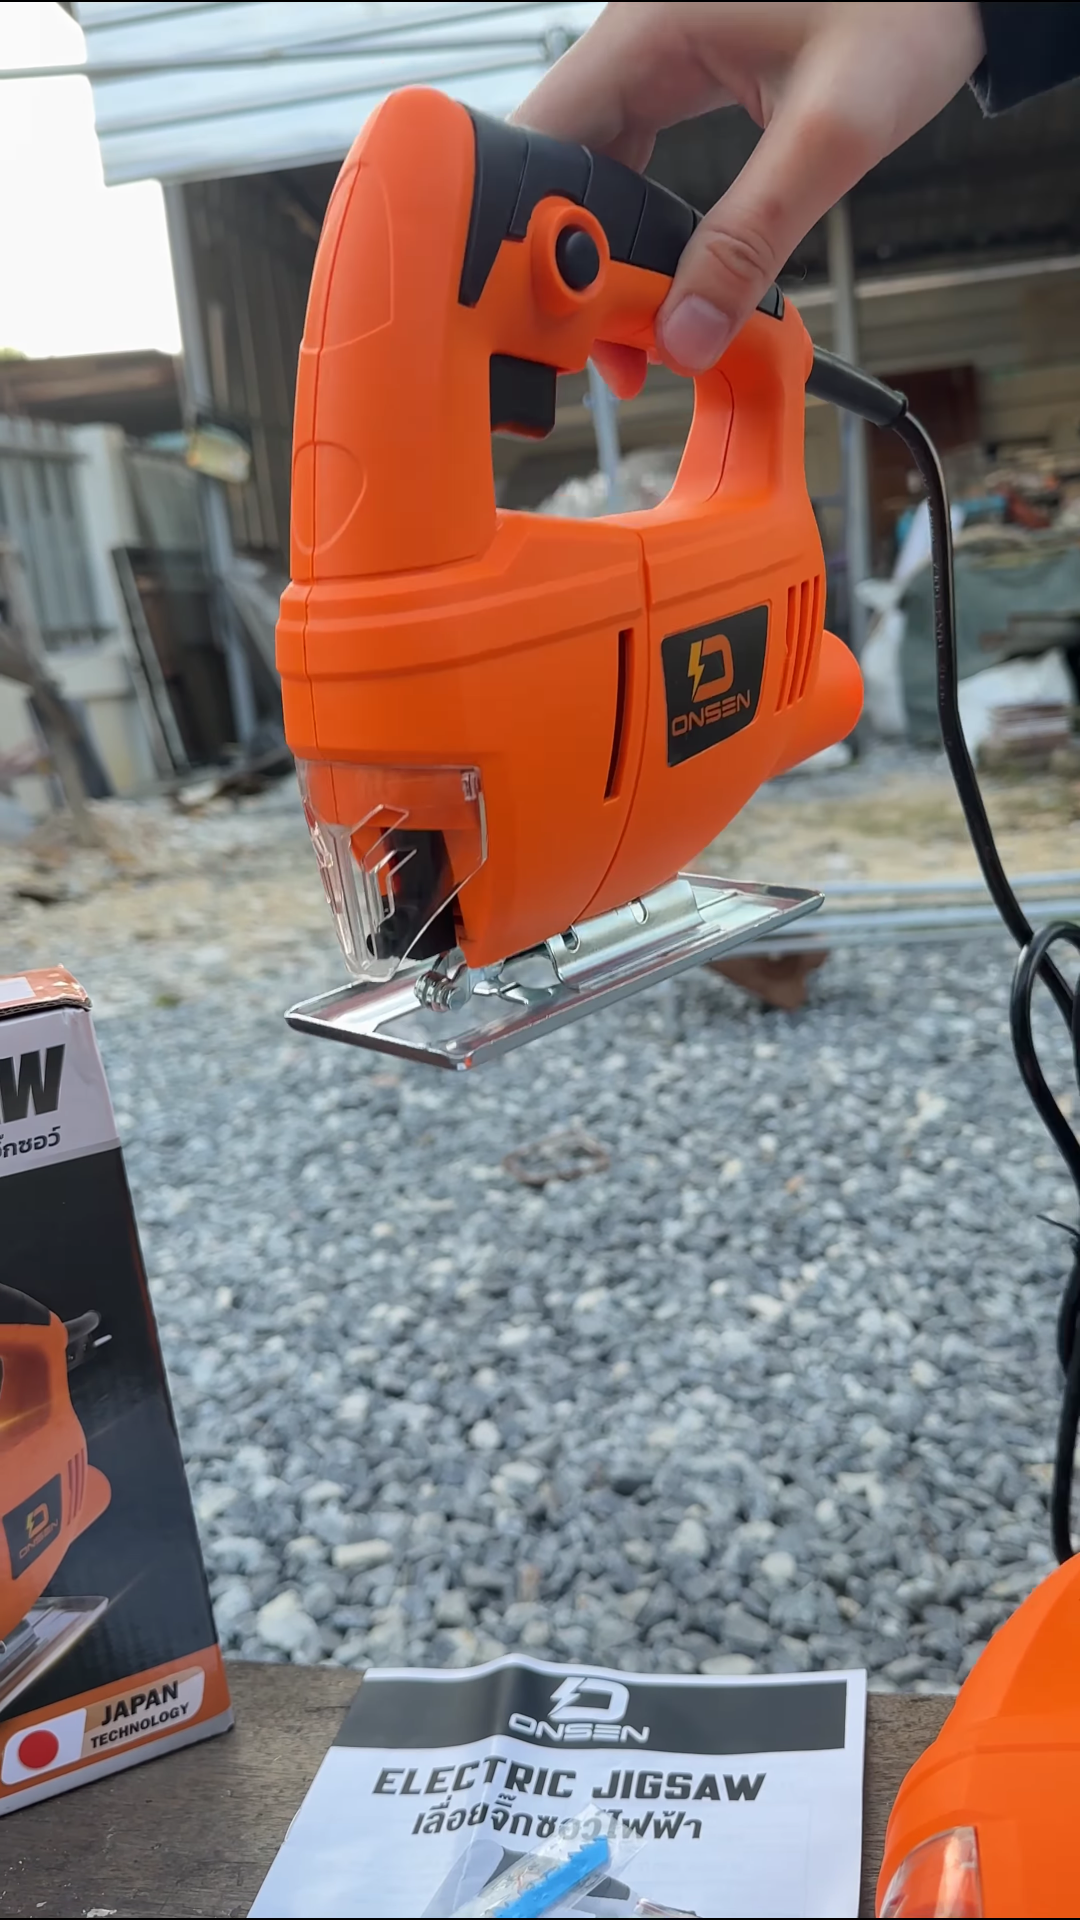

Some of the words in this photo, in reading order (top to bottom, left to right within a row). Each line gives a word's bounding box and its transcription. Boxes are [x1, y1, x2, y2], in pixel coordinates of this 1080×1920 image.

[671, 689, 751, 737] ONSEN
[0, 1043, 65, 1124] W
[19, 1518, 58, 1559] ONSEN
[90, 1702, 189, 1748] TECHNOLOGY
[101, 1680, 178, 1726] JAPAN
[508, 1712, 651, 1744] ONSEN
[372, 1754, 577, 1798] ELECTRIC
[592, 1769, 767, 1801] JIGSAW
